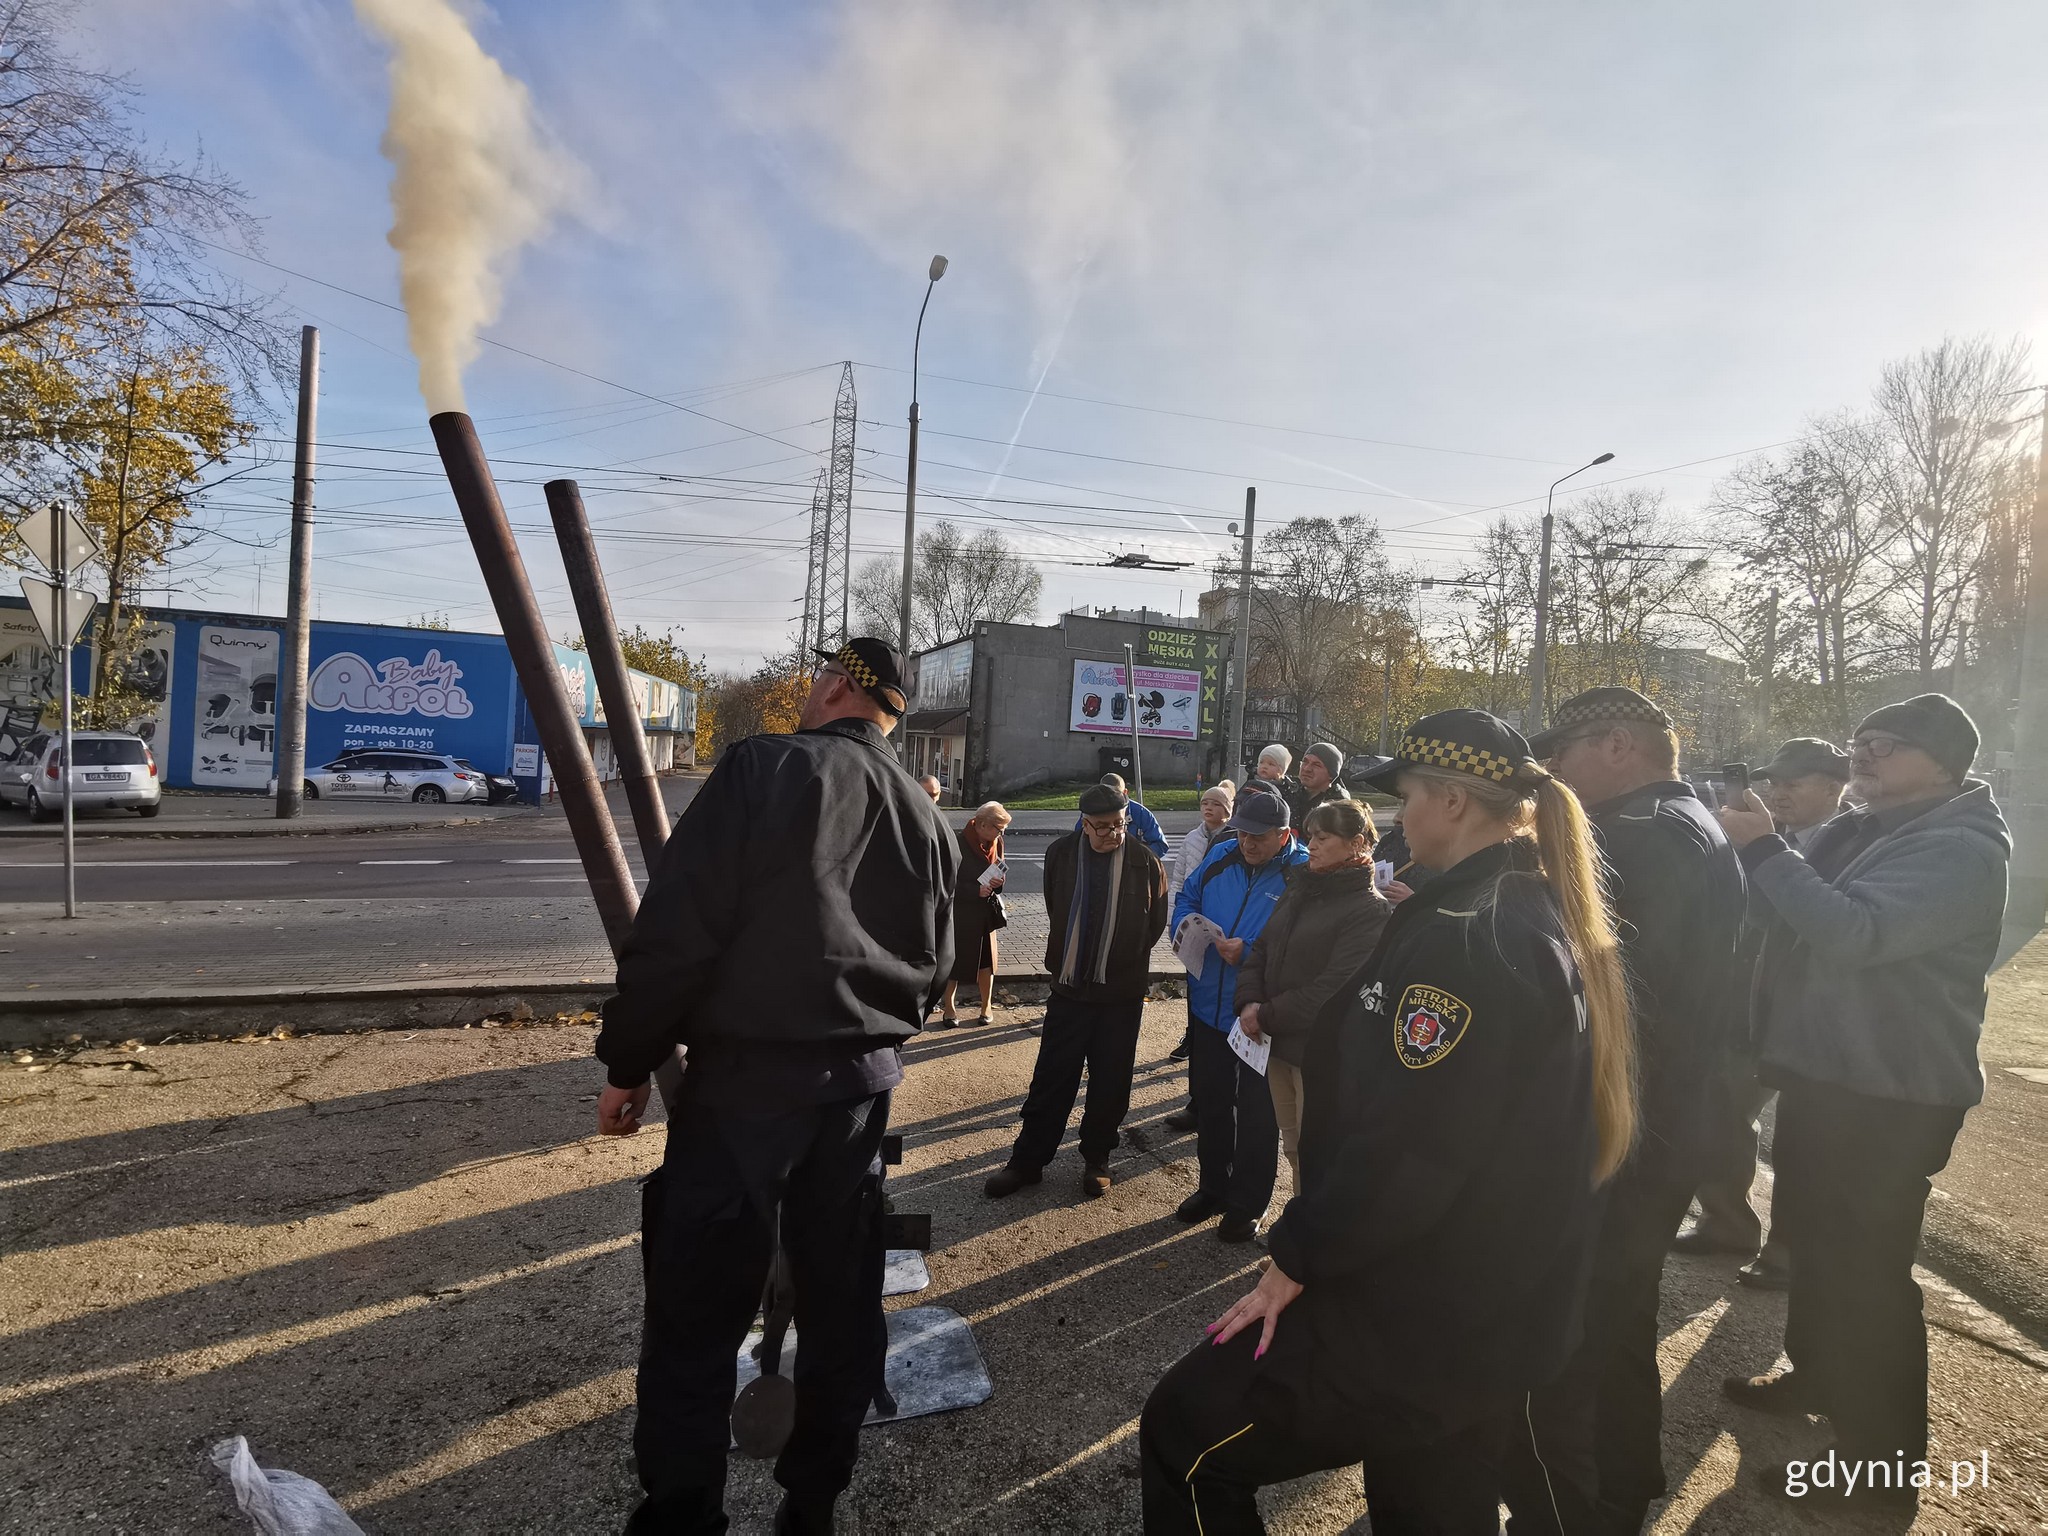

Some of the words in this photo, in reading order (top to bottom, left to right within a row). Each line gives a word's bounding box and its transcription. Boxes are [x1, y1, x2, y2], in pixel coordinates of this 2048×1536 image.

[2, 622, 38, 633] Safety
[209, 634, 267, 650] Quinny
[1148, 630, 1197, 646] ODZIEŻ
[1148, 643, 1194, 659] MĘSKA
[380, 651, 461, 690] Baby
[1153, 671, 1164, 679] dla
[1165, 672, 1190, 681] dziecka
[344, 724, 435, 737] ZAPRASZAMY
[344, 738, 364, 748] pon
[377, 739, 396, 748] sob
[401, 739, 434, 750] 10-20
[1414, 988, 1460, 1014] STRAŻ
[1408, 998, 1458, 1023] MIEJSKA
[1403, 1053, 1422, 1065] CITY
[1426, 1040, 1451, 1061] GUARD
